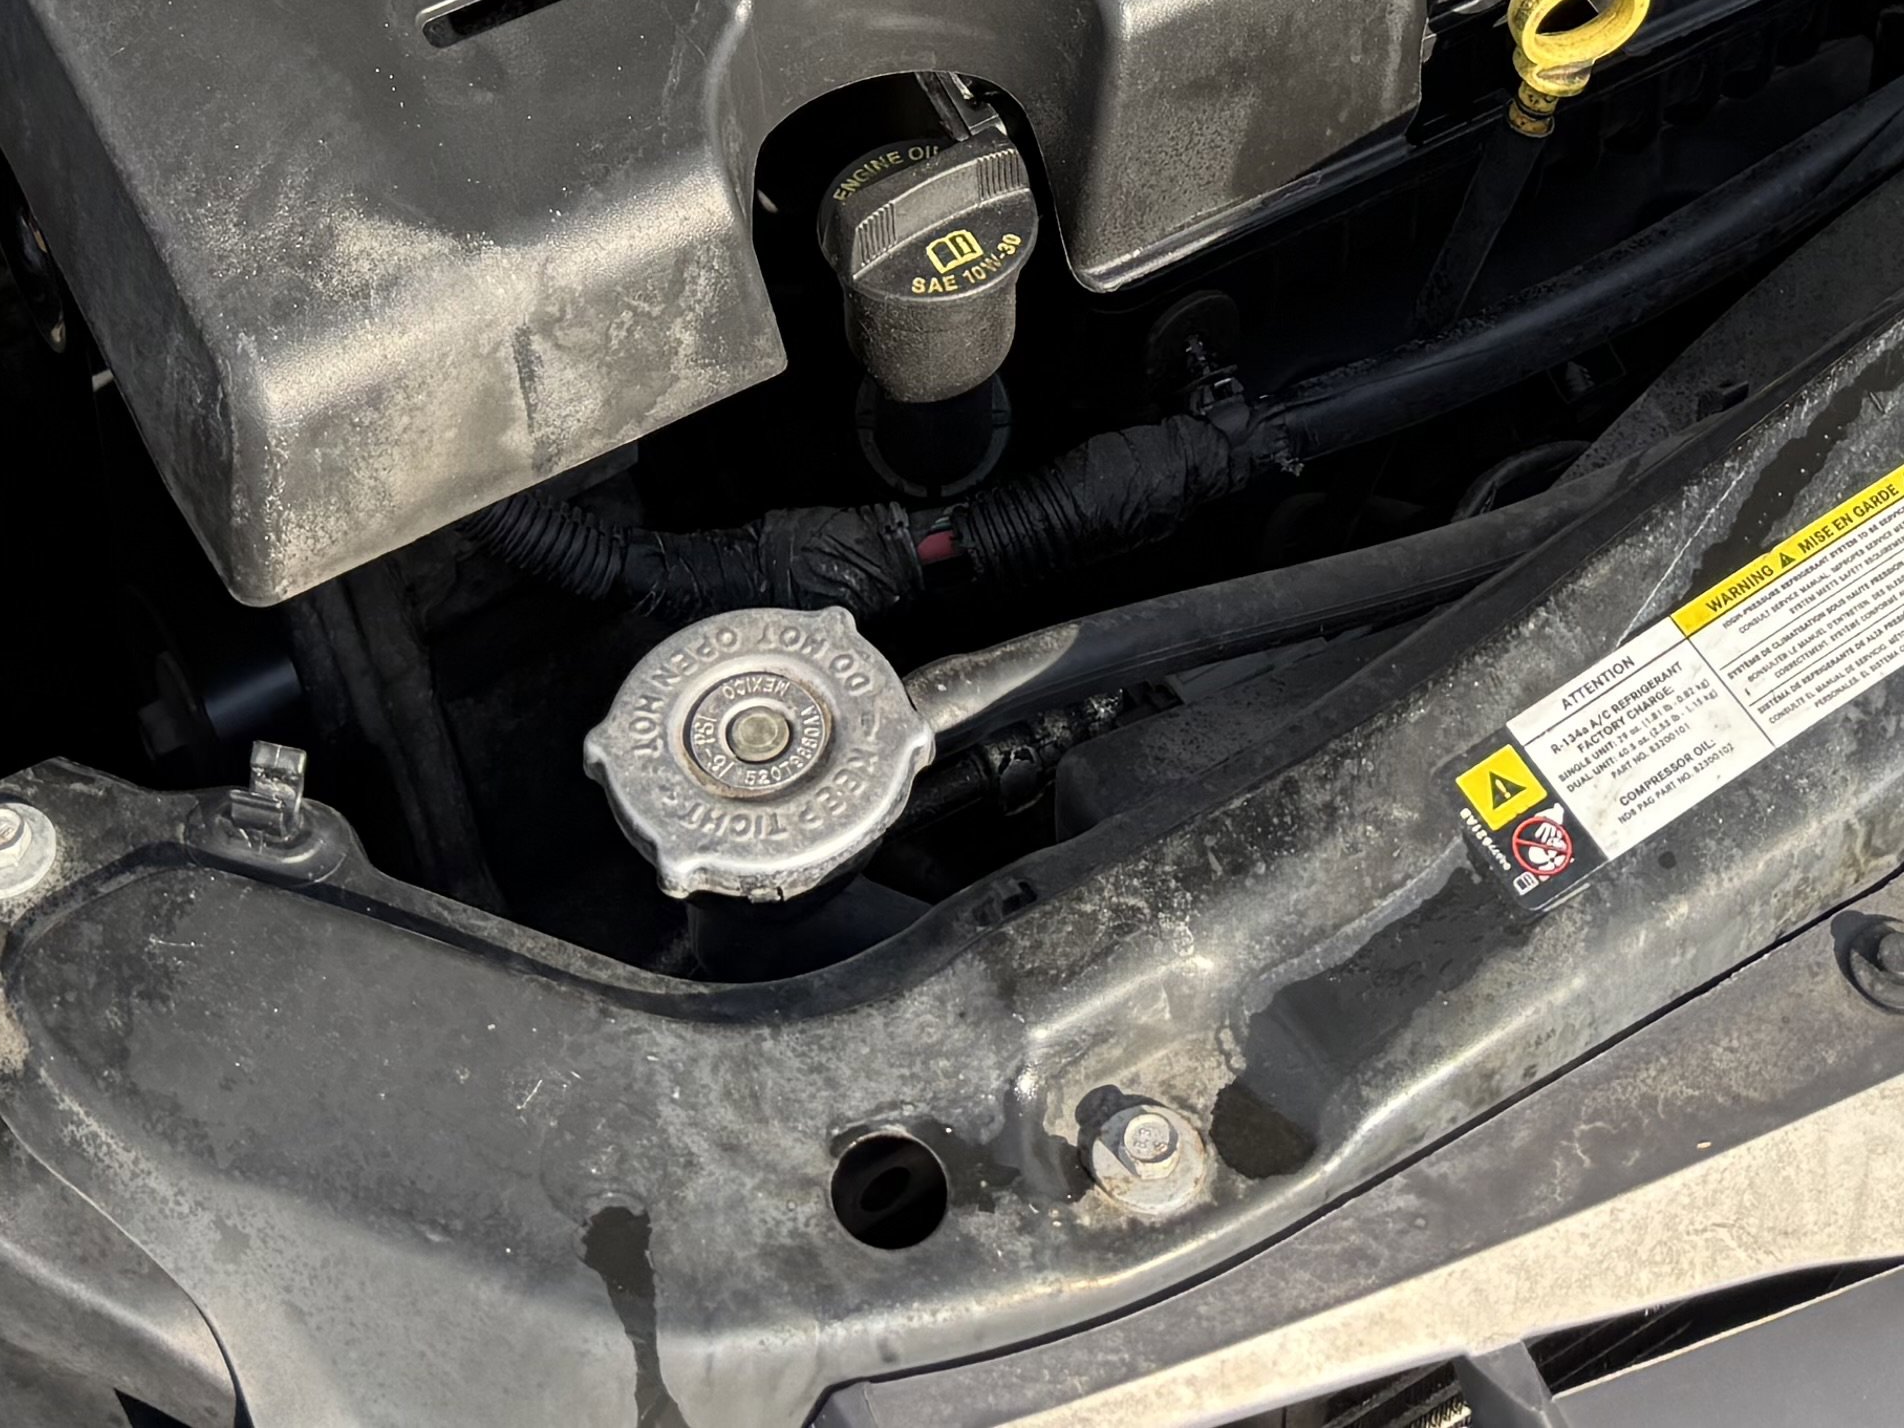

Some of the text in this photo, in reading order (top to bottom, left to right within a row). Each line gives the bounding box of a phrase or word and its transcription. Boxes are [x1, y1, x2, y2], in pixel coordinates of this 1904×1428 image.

[833, 150, 902, 206] ENGINE
[911, 232, 1023, 295] SAE 10W-30
[1705, 563, 1776, 613] WARNING
[1797, 525, 1835, 553] MISE
[1832, 512, 1854, 531] EN
[1851, 482, 1899, 518] GARDE
[1780, 555, 1830, 590] REFRIGERANT
[1858, 530, 1869, 540] TO
[1737, 609, 1771, 634] CONSULT
[1770, 590, 1799, 612] SERVICE
[1760, 646, 1772, 657] DE
[629, 626, 871, 757] DO NOT OPEN HOT
[722, 677, 790, 699] MEXICO
[1550, 660, 1685, 753] R-134a A/C REFRIGERANT
[1558, 655, 1637, 710] ATTENTION
[1789, 681, 1802, 692] DE
[1575, 683, 1675, 753] FACTORY CHARGE:
[1556, 756, 1592, 782] SINGLE
[1590, 739, 1618, 760] UNIT:
[1565, 771, 1594, 793] DUAL
[1591, 754, 1618, 775] UNIT:
[1609, 760, 1633, 779] PART
[1632, 749, 1650, 764] NO.
[1617, 736, 1717, 806] COMPRESSOR OIL:
[679, 747, 875, 840] KEEP TIGHT
[1636, 795, 1656, 811] PAG
[1654, 781, 1677, 799] PART
[1676, 769, 1694, 784] NO.
